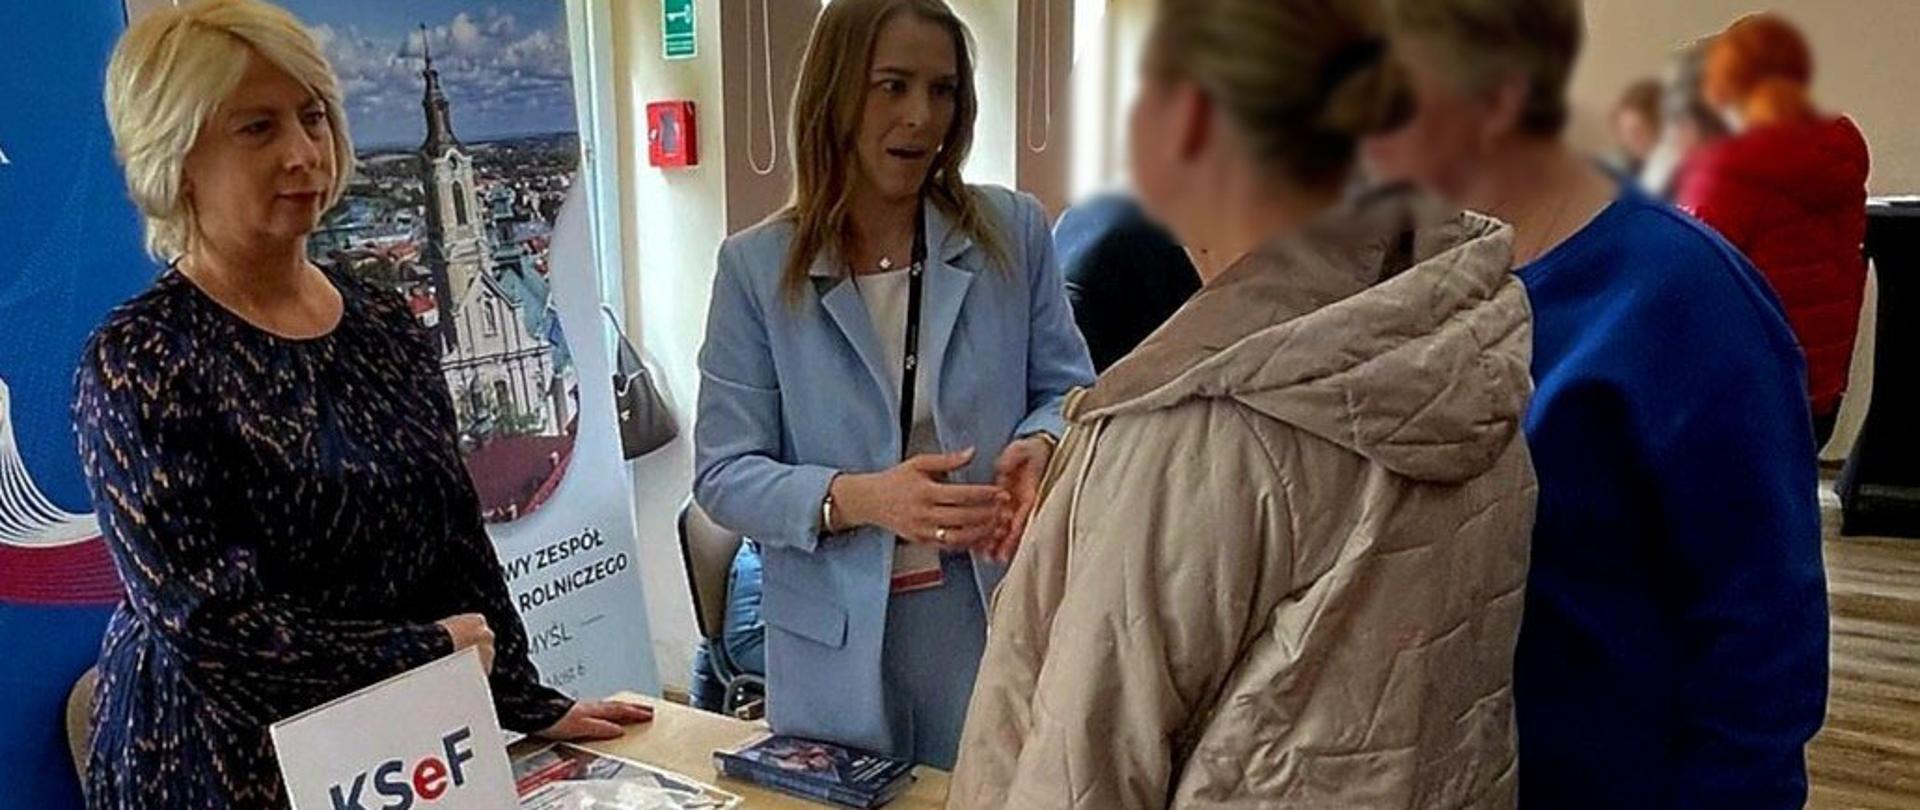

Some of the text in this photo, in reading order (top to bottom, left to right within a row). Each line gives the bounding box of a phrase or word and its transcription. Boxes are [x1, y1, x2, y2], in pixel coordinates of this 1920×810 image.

[535, 527, 603, 569] ZESPÓŁ
[518, 553, 627, 613] ROLNICZEGO
[329, 726, 474, 810] KSeF
